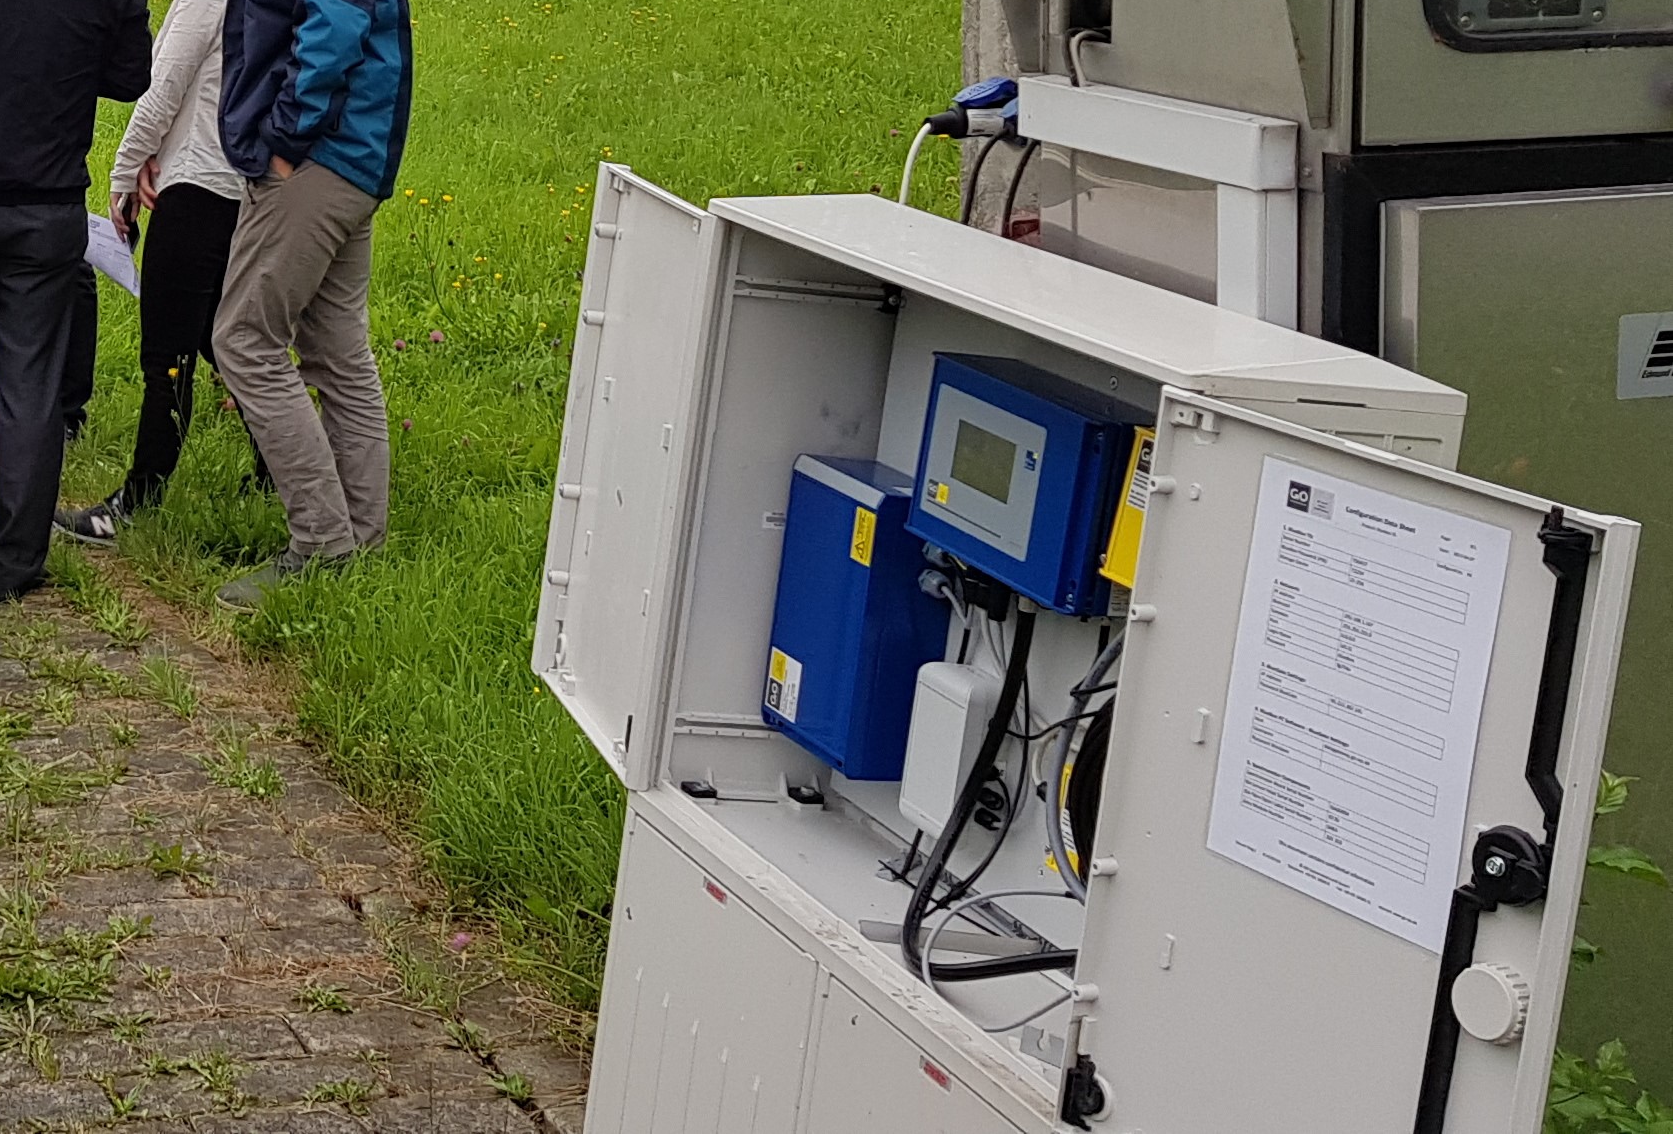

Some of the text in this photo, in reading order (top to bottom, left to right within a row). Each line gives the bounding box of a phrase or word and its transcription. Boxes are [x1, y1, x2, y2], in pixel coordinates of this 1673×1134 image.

[1289, 487, 1309, 502] GO
[90, 515, 116, 535] N
[1345, 506, 1383, 523] Configuration
[1384, 518, 1398, 528] Data
[1399, 522, 1416, 534] Sheet
